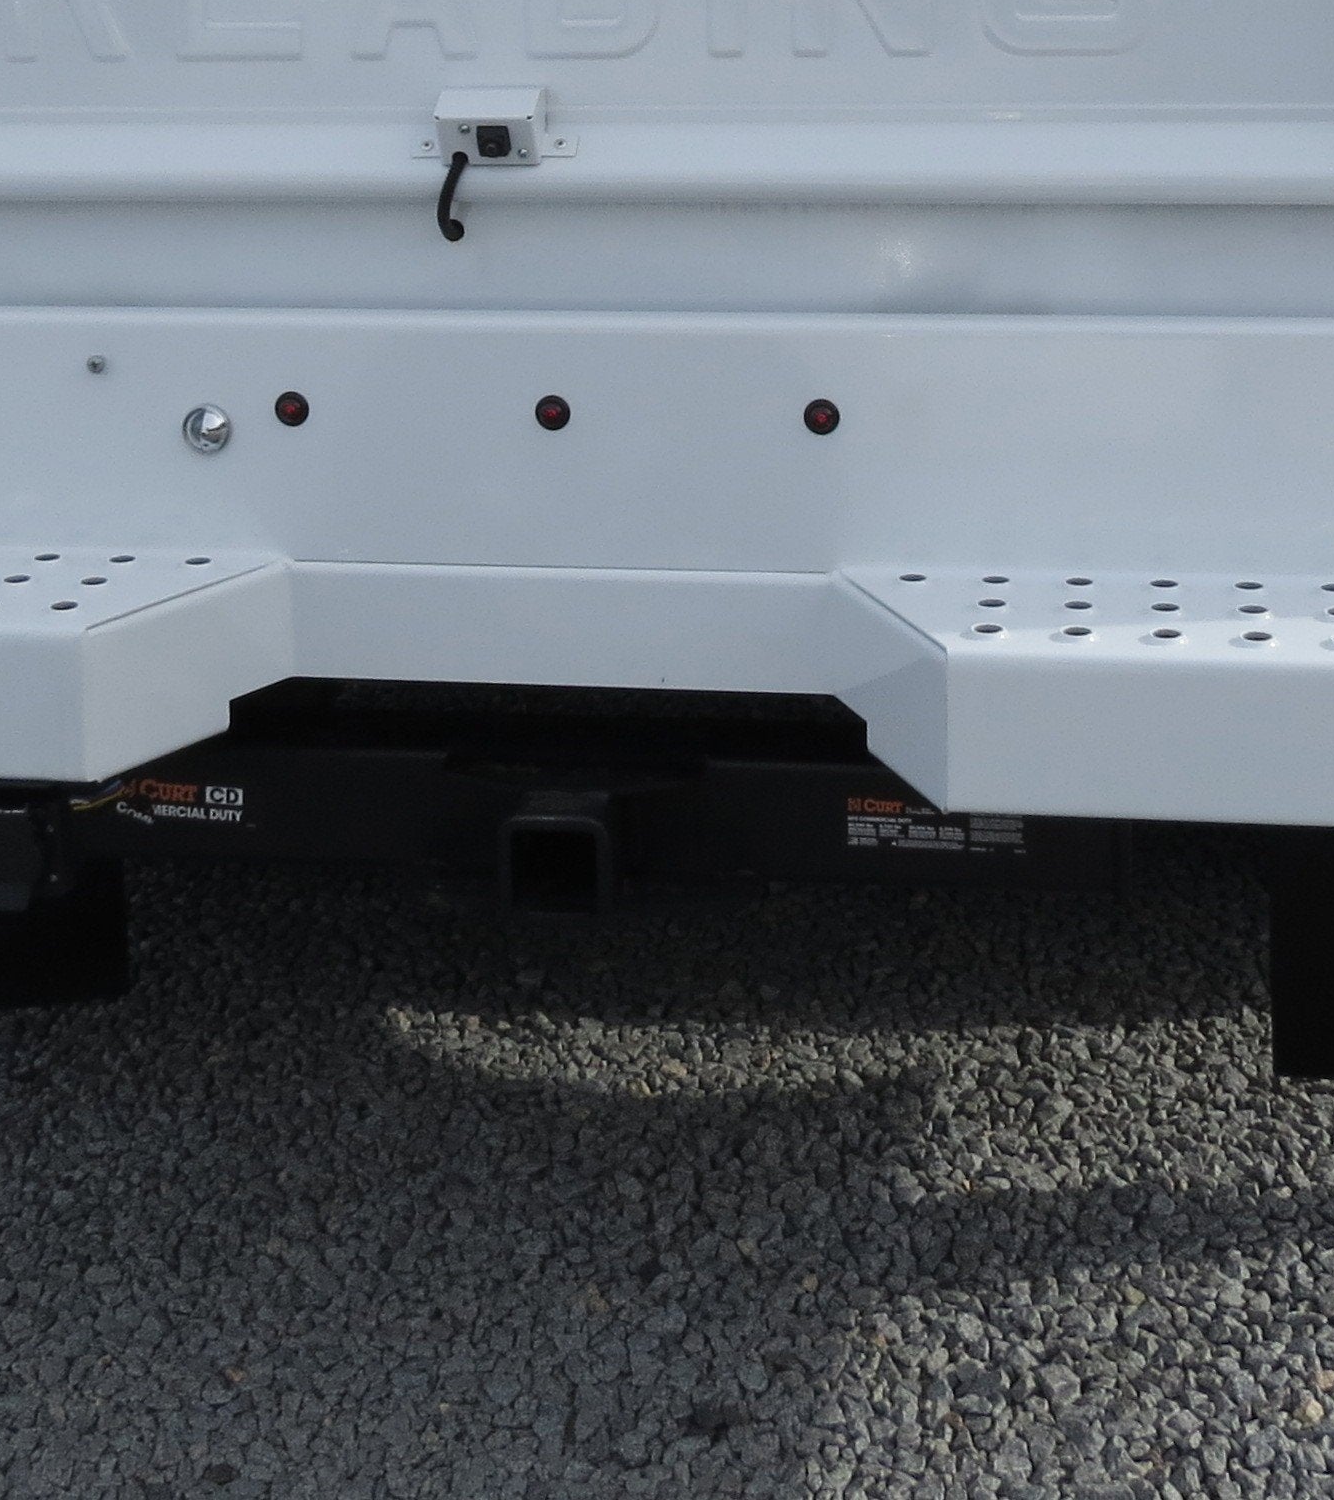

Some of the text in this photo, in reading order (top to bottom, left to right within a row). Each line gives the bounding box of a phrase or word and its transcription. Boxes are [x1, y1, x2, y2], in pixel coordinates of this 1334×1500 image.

[140, 778, 240, 804] CURT CD
[864, 798, 904, 814] CURT
[209, 808, 243, 822] DUTY
